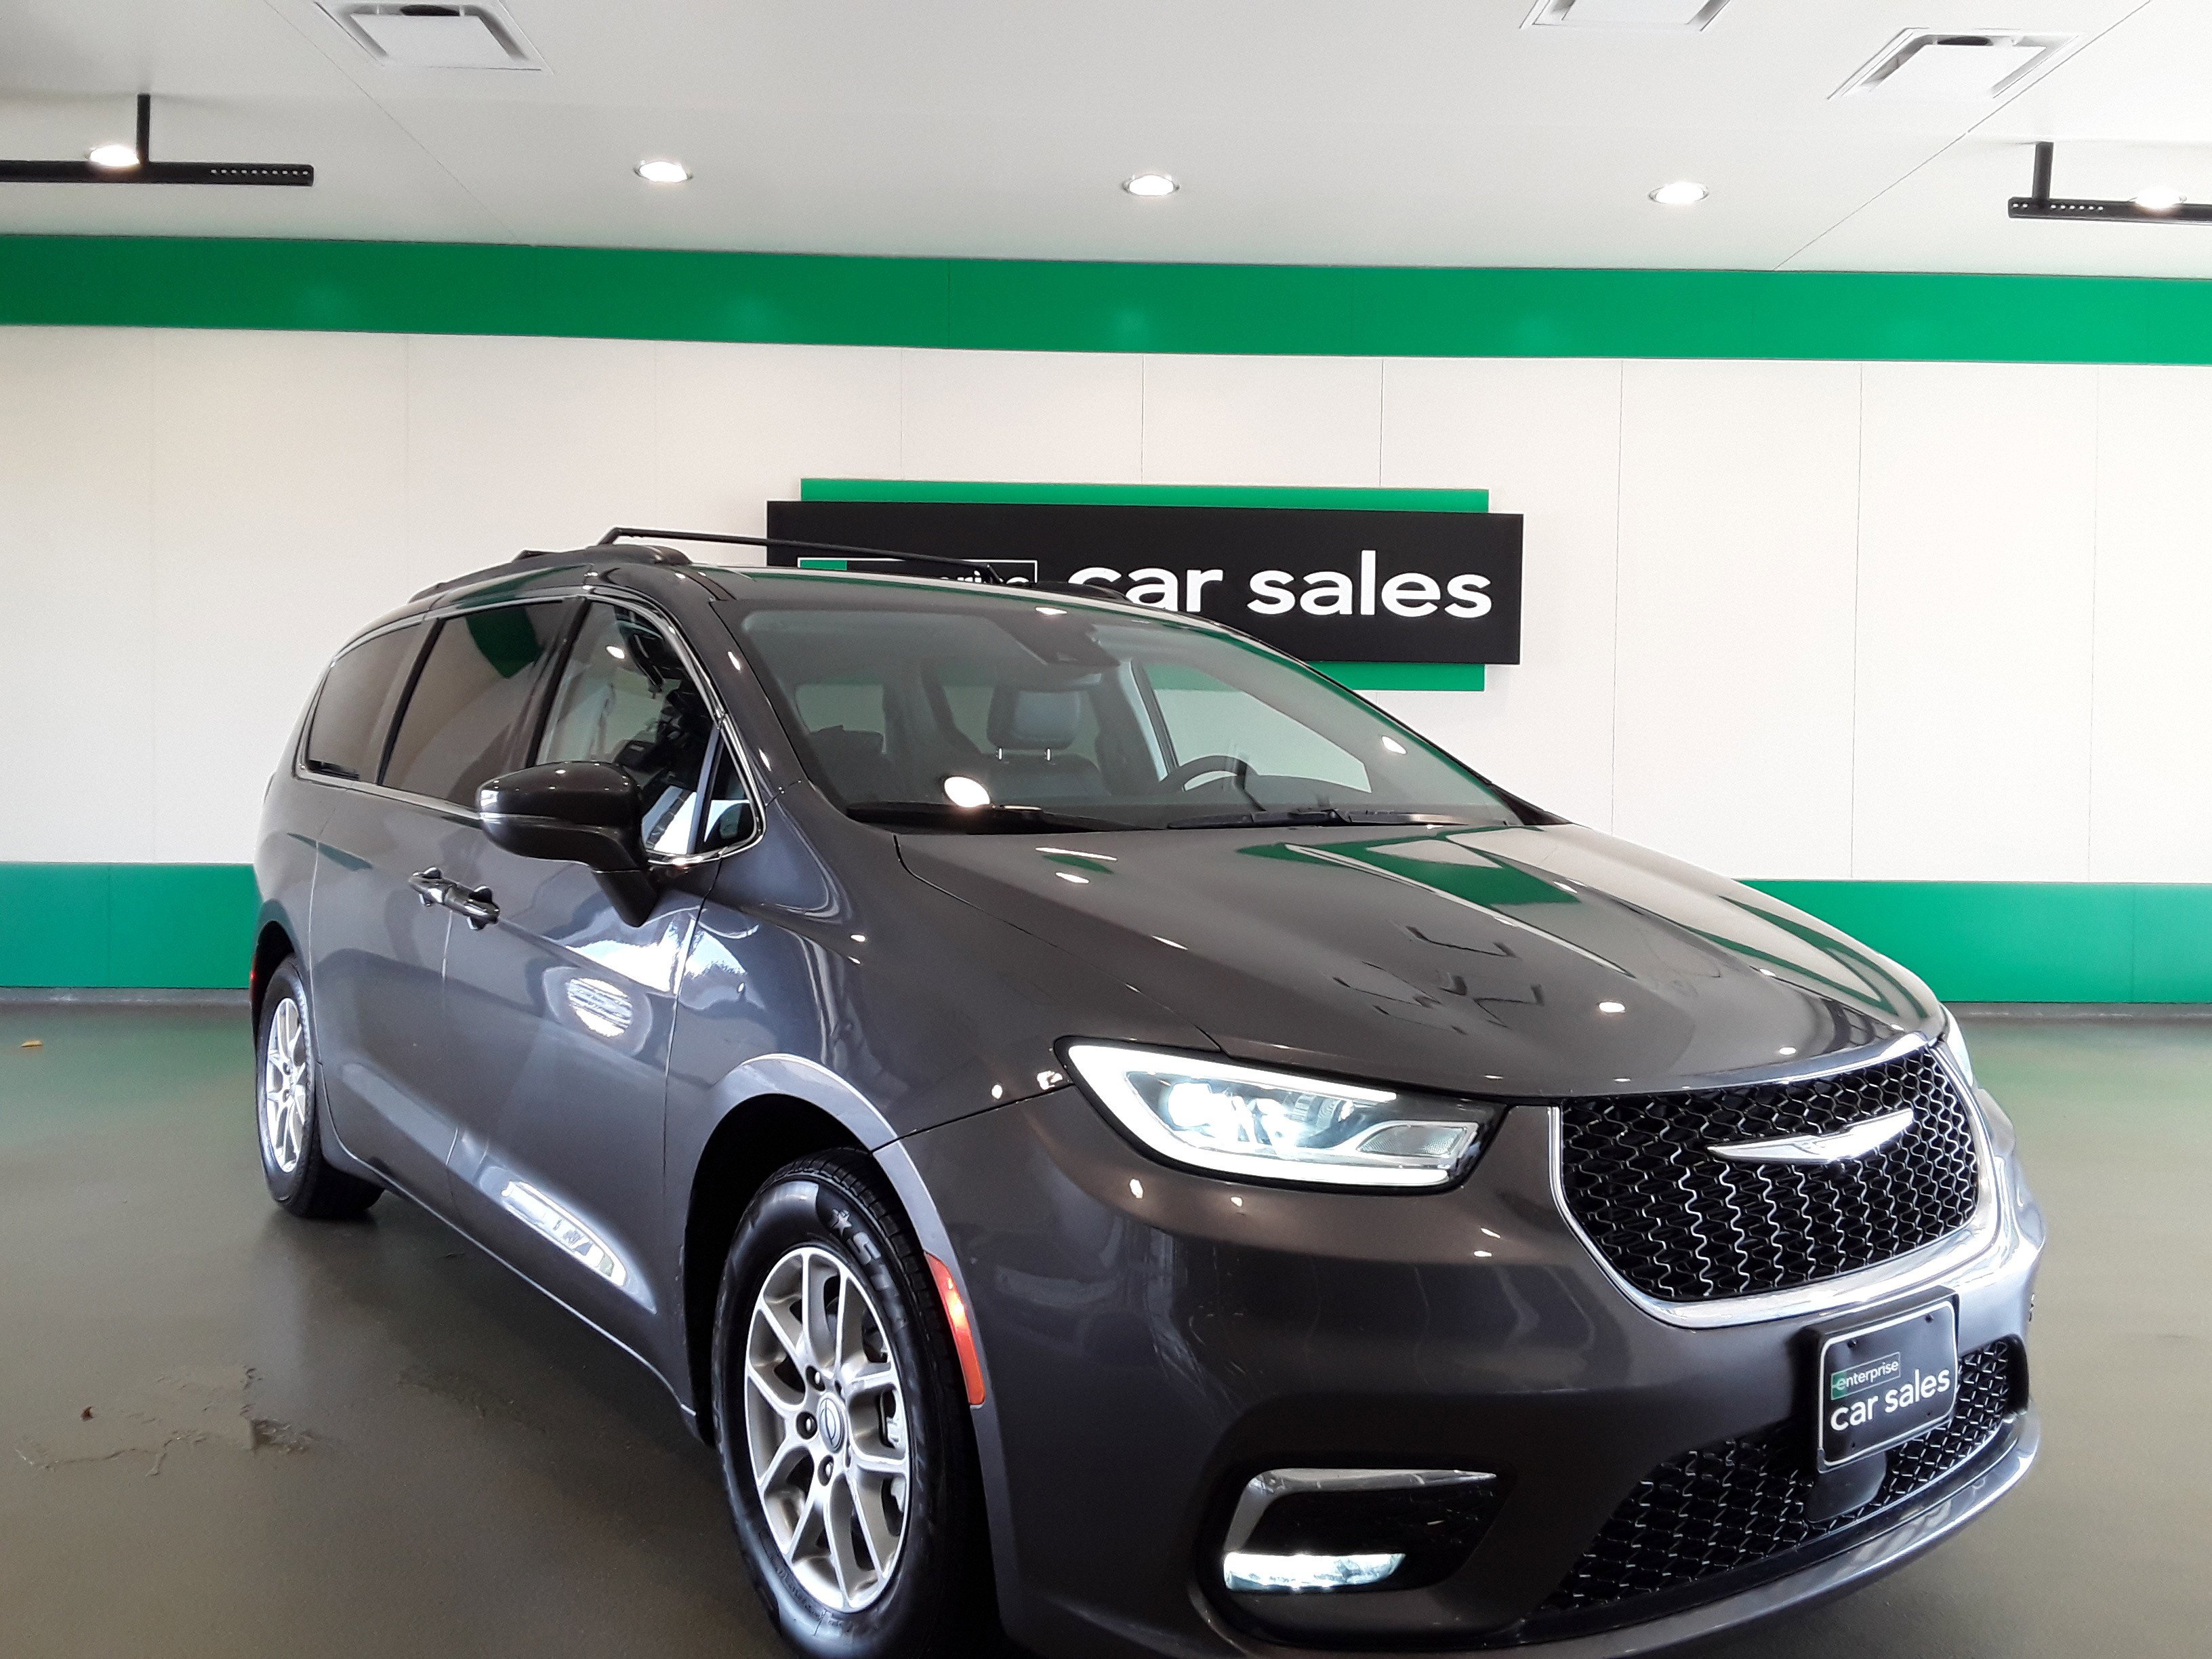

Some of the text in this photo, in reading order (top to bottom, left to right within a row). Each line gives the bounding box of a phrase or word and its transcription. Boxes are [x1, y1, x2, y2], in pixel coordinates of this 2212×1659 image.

[1247, 550, 1492, 618] sales
[1830, 1368, 1950, 1431] car sales
[1837, 1361, 1900, 1391] enterprise
